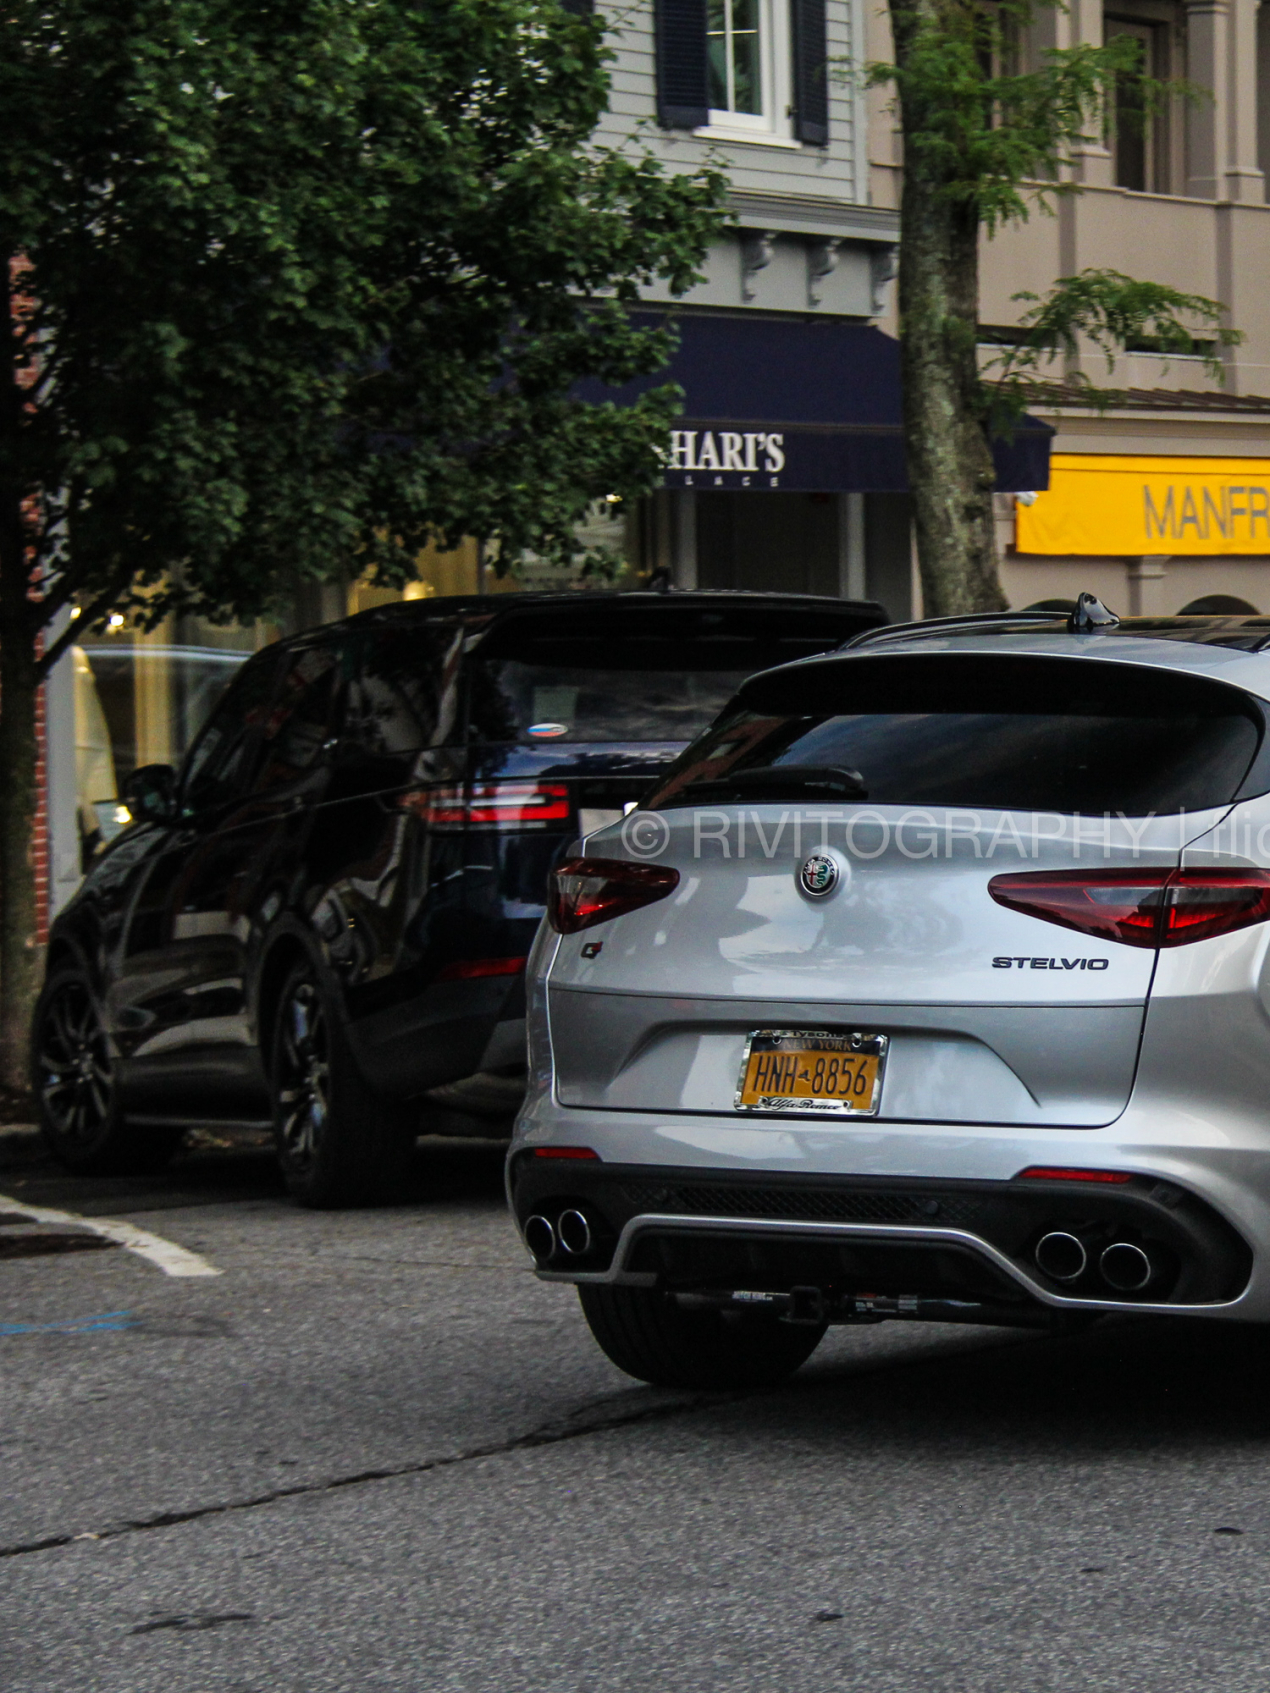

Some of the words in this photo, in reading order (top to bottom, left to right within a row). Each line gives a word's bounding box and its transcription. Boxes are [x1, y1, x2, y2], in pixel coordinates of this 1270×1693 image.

[991, 956, 1110, 971] STELVIO
[783, 1038, 815, 1050] NEW
[818, 1039, 852, 1052] YORK
